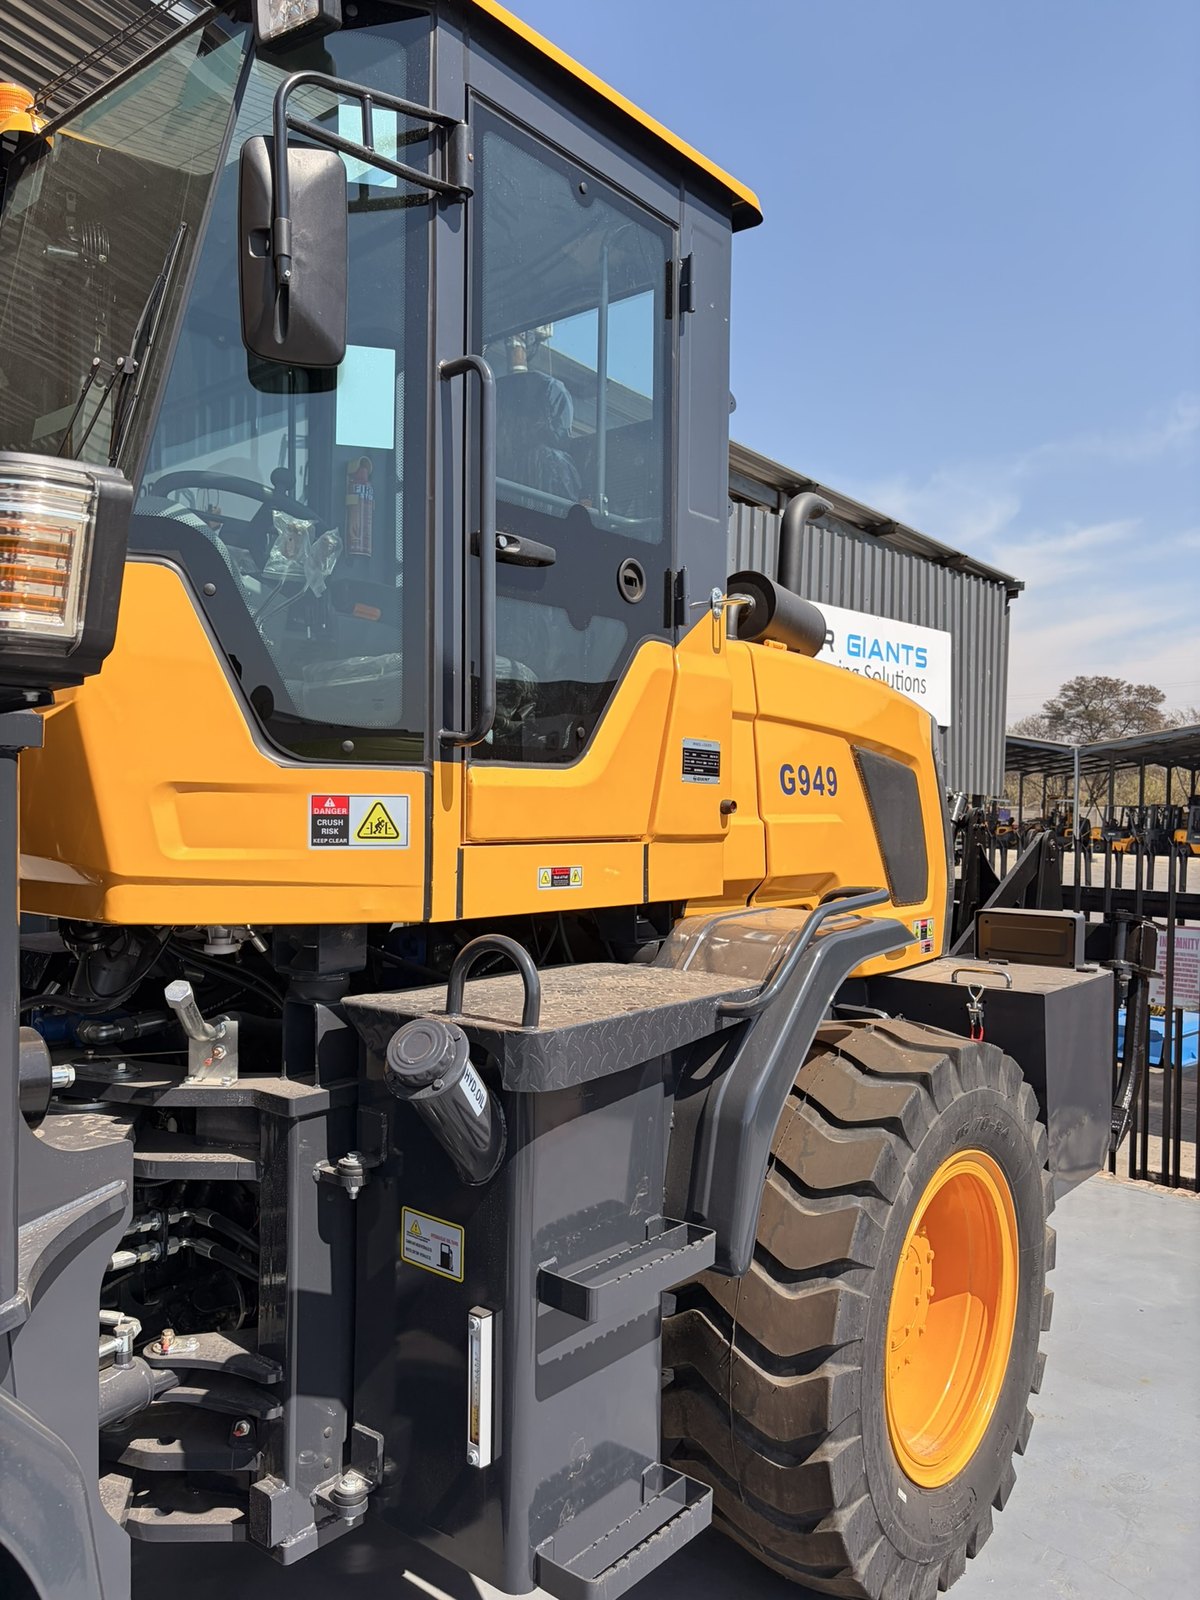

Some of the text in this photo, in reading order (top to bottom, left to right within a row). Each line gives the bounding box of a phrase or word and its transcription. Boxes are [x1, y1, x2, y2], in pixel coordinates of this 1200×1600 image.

[847, 633, 928, 669] GIANTS
[779, 763, 838, 797] G949
[313, 807, 347, 815] DANGER
[316, 818, 344, 826] CRUSH
[321, 827, 339, 835] RISK
